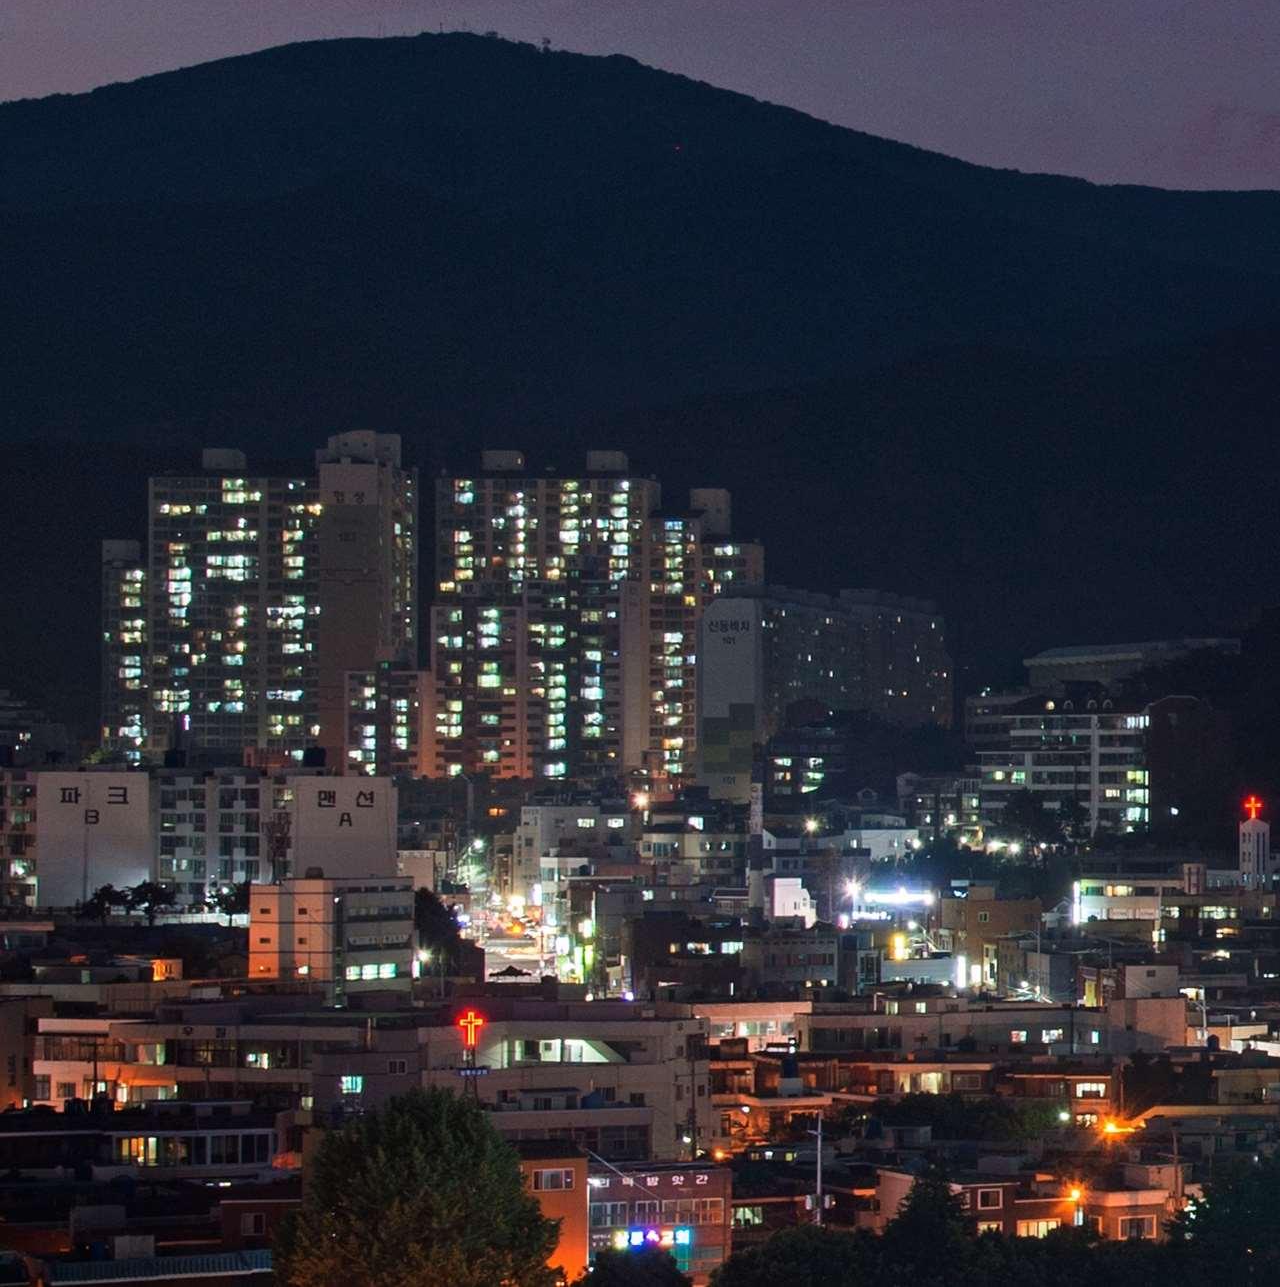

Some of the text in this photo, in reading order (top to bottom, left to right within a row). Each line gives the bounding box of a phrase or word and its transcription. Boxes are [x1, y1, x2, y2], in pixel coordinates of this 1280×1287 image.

[317, 790, 375, 808] 맨션
[84, 809, 100, 825] B
[339, 812, 353, 827] A
